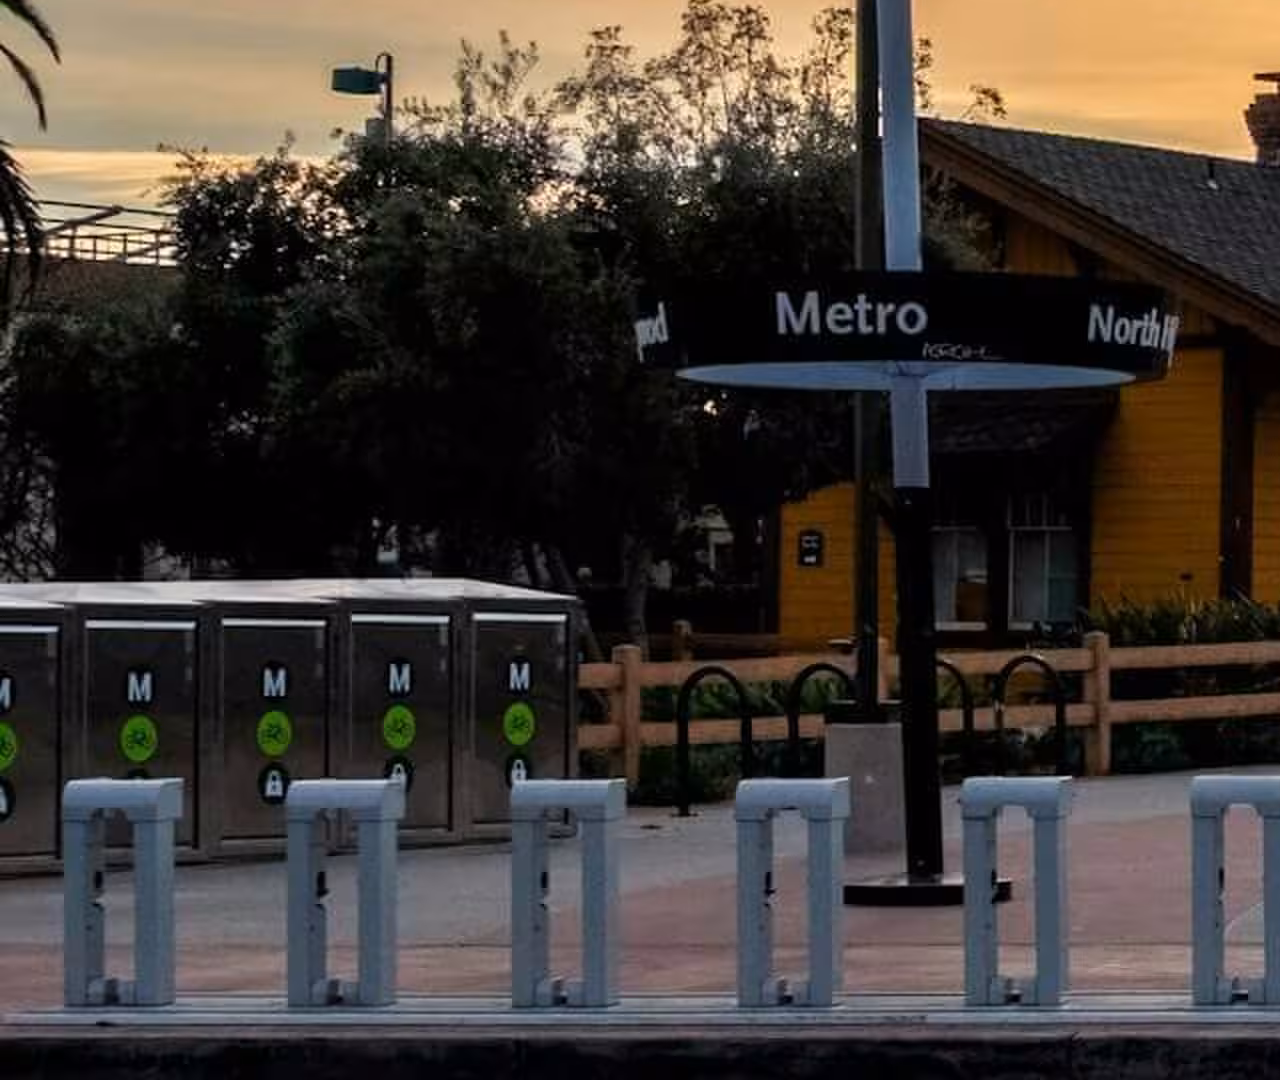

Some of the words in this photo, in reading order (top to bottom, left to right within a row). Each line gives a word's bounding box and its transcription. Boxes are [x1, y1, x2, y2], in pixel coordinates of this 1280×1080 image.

[775, 289, 929, 336] Metro
[128, 672, 152, 702] M
[263, 668, 287, 698] M
[390, 662, 411, 692] M
[510, 662, 530, 690] M
